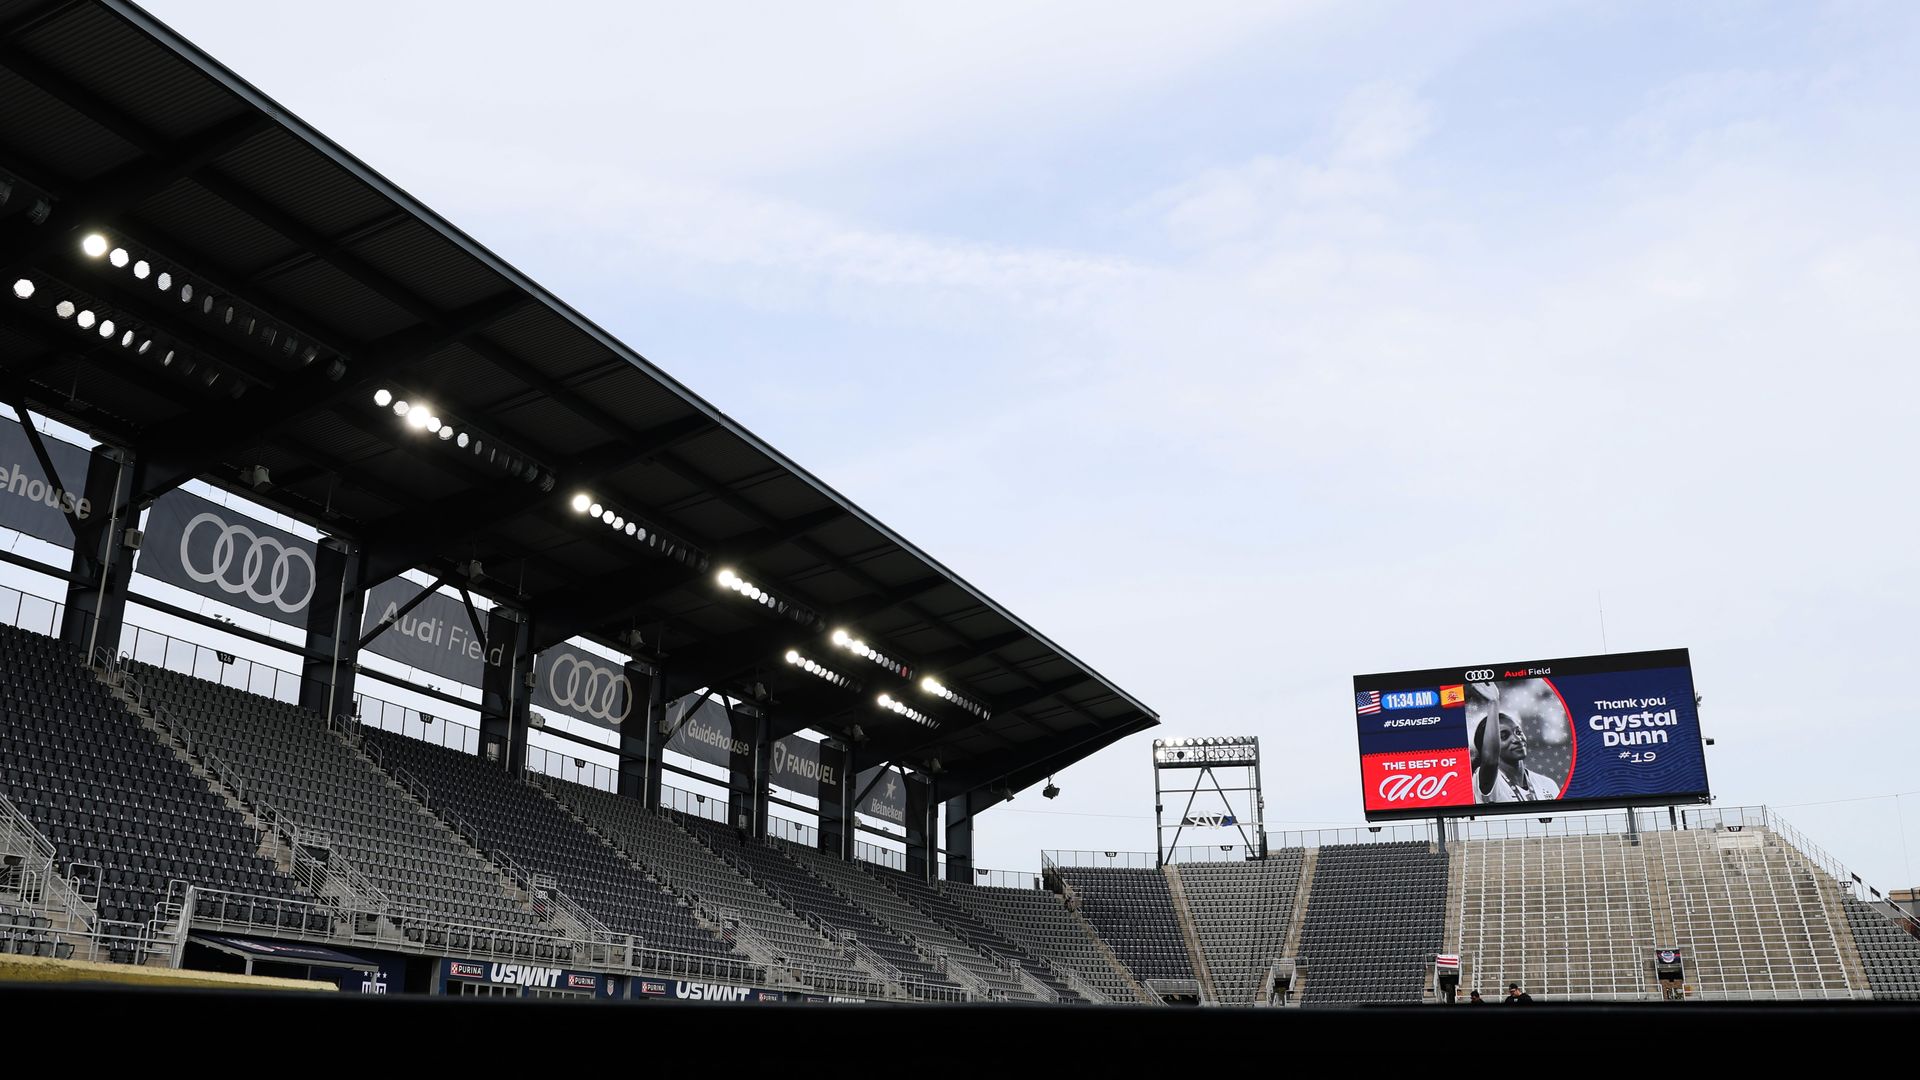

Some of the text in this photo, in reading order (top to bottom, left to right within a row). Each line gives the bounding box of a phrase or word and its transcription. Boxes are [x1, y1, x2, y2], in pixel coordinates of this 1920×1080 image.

[378, 600, 443, 646] Audi
[1504, 667, 1551, 678] Audi Field
[1386, 691, 1432, 708] 11:34 AM
[1594, 697, 1666, 710] Thank you
[1589, 709, 1678, 732] Crystal
[687, 719, 750, 756] Guidehouse
[1603, 729, 1668, 747] Dunn
[1382, 758, 1456, 770] THE BEST OF
[1618, 751, 1656, 763] #19
[786, 753, 837, 786] FANDUEL
[871, 798, 903, 822] Heineken
[458, 965, 482, 976] PURINA
[490, 963, 562, 988] USWNT
[574, 977, 595, 985] PURINA
[675, 981, 750, 1002] USWNT
